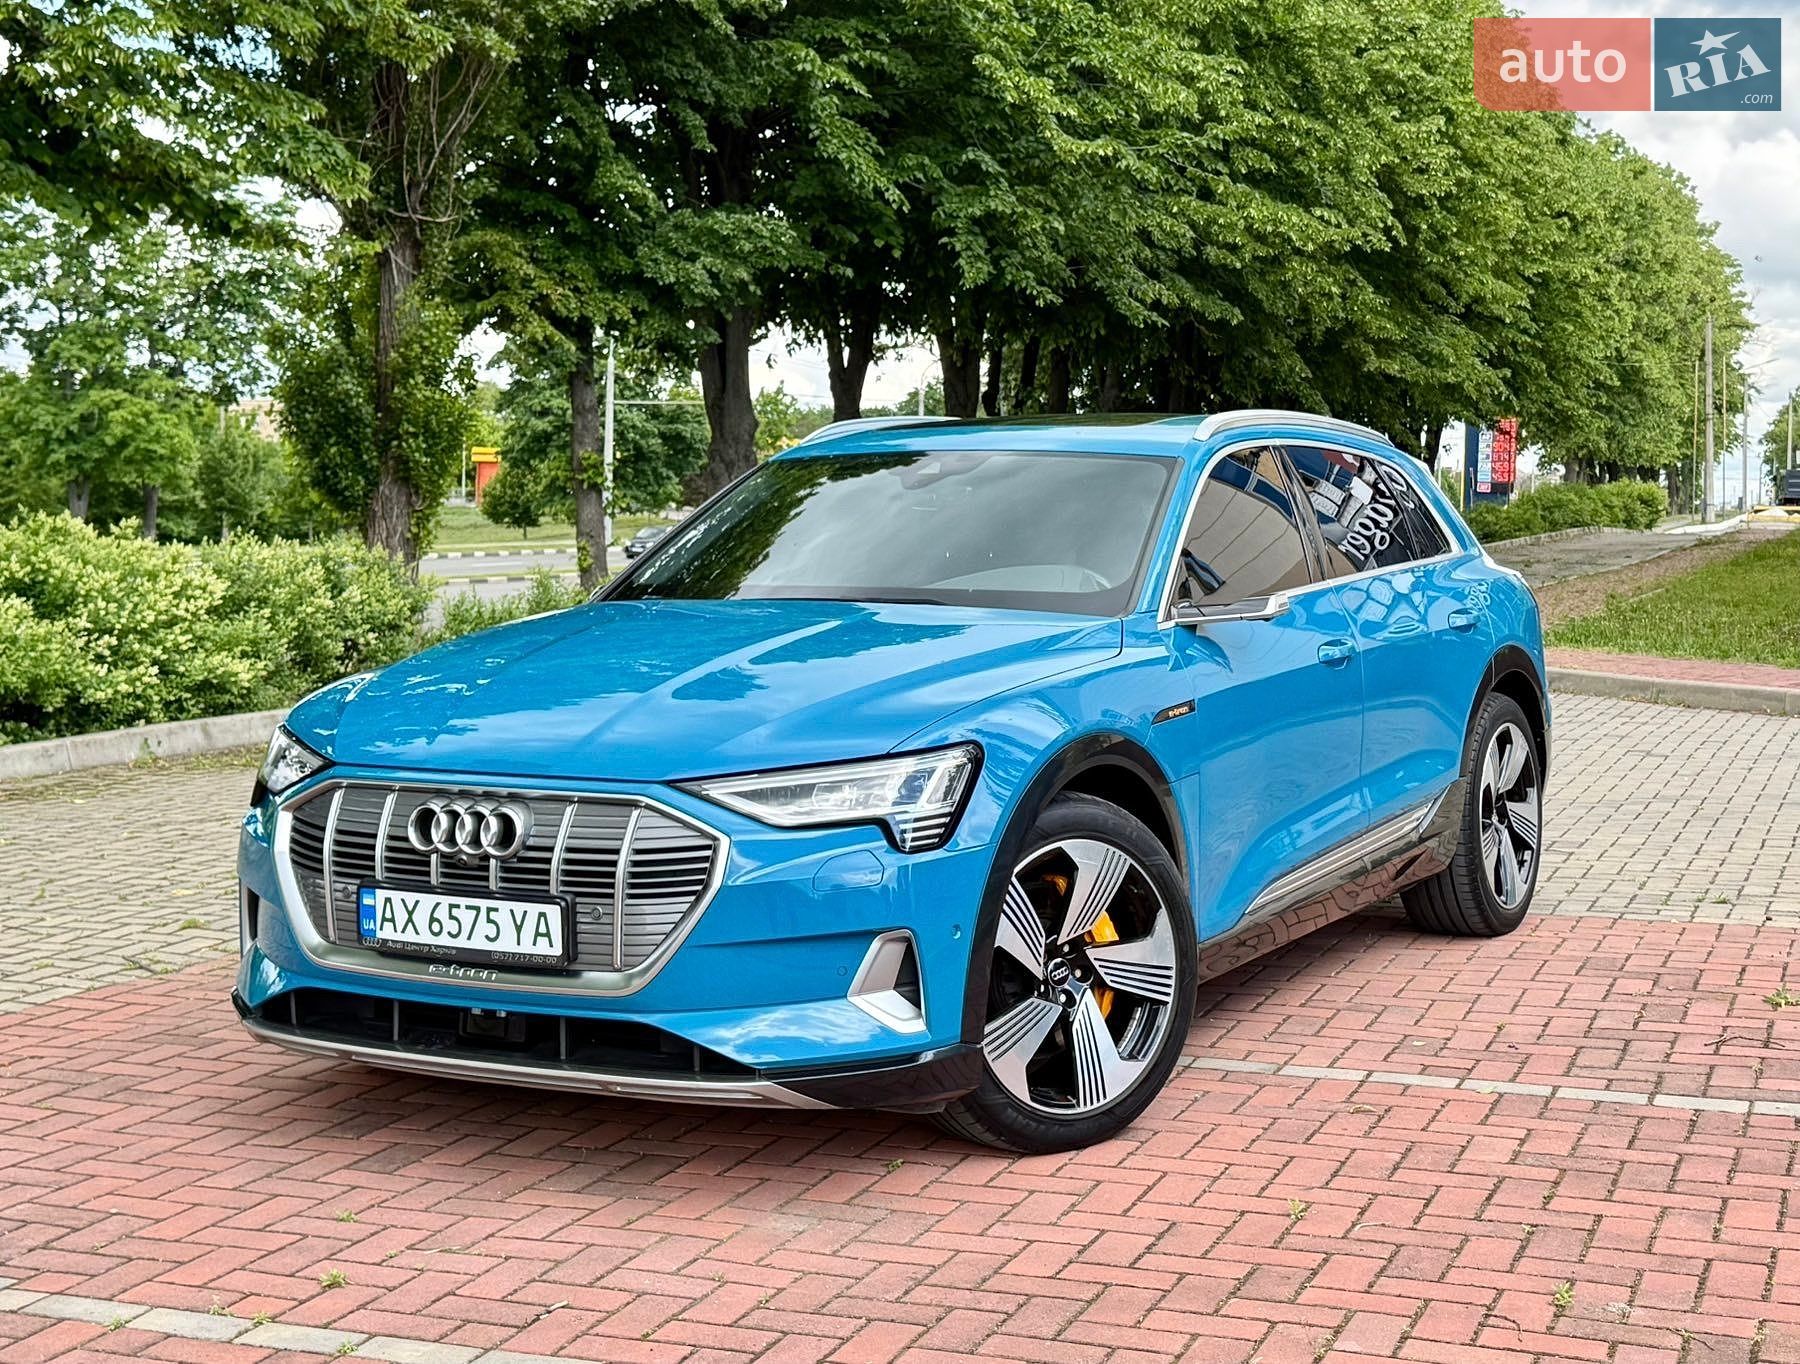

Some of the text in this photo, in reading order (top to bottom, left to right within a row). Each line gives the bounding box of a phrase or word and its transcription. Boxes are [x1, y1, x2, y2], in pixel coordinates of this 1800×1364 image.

[363, 917, 376, 930] UA
[379, 896, 554, 948] AX 6575 YA
[386, 940, 403, 949] Audi
